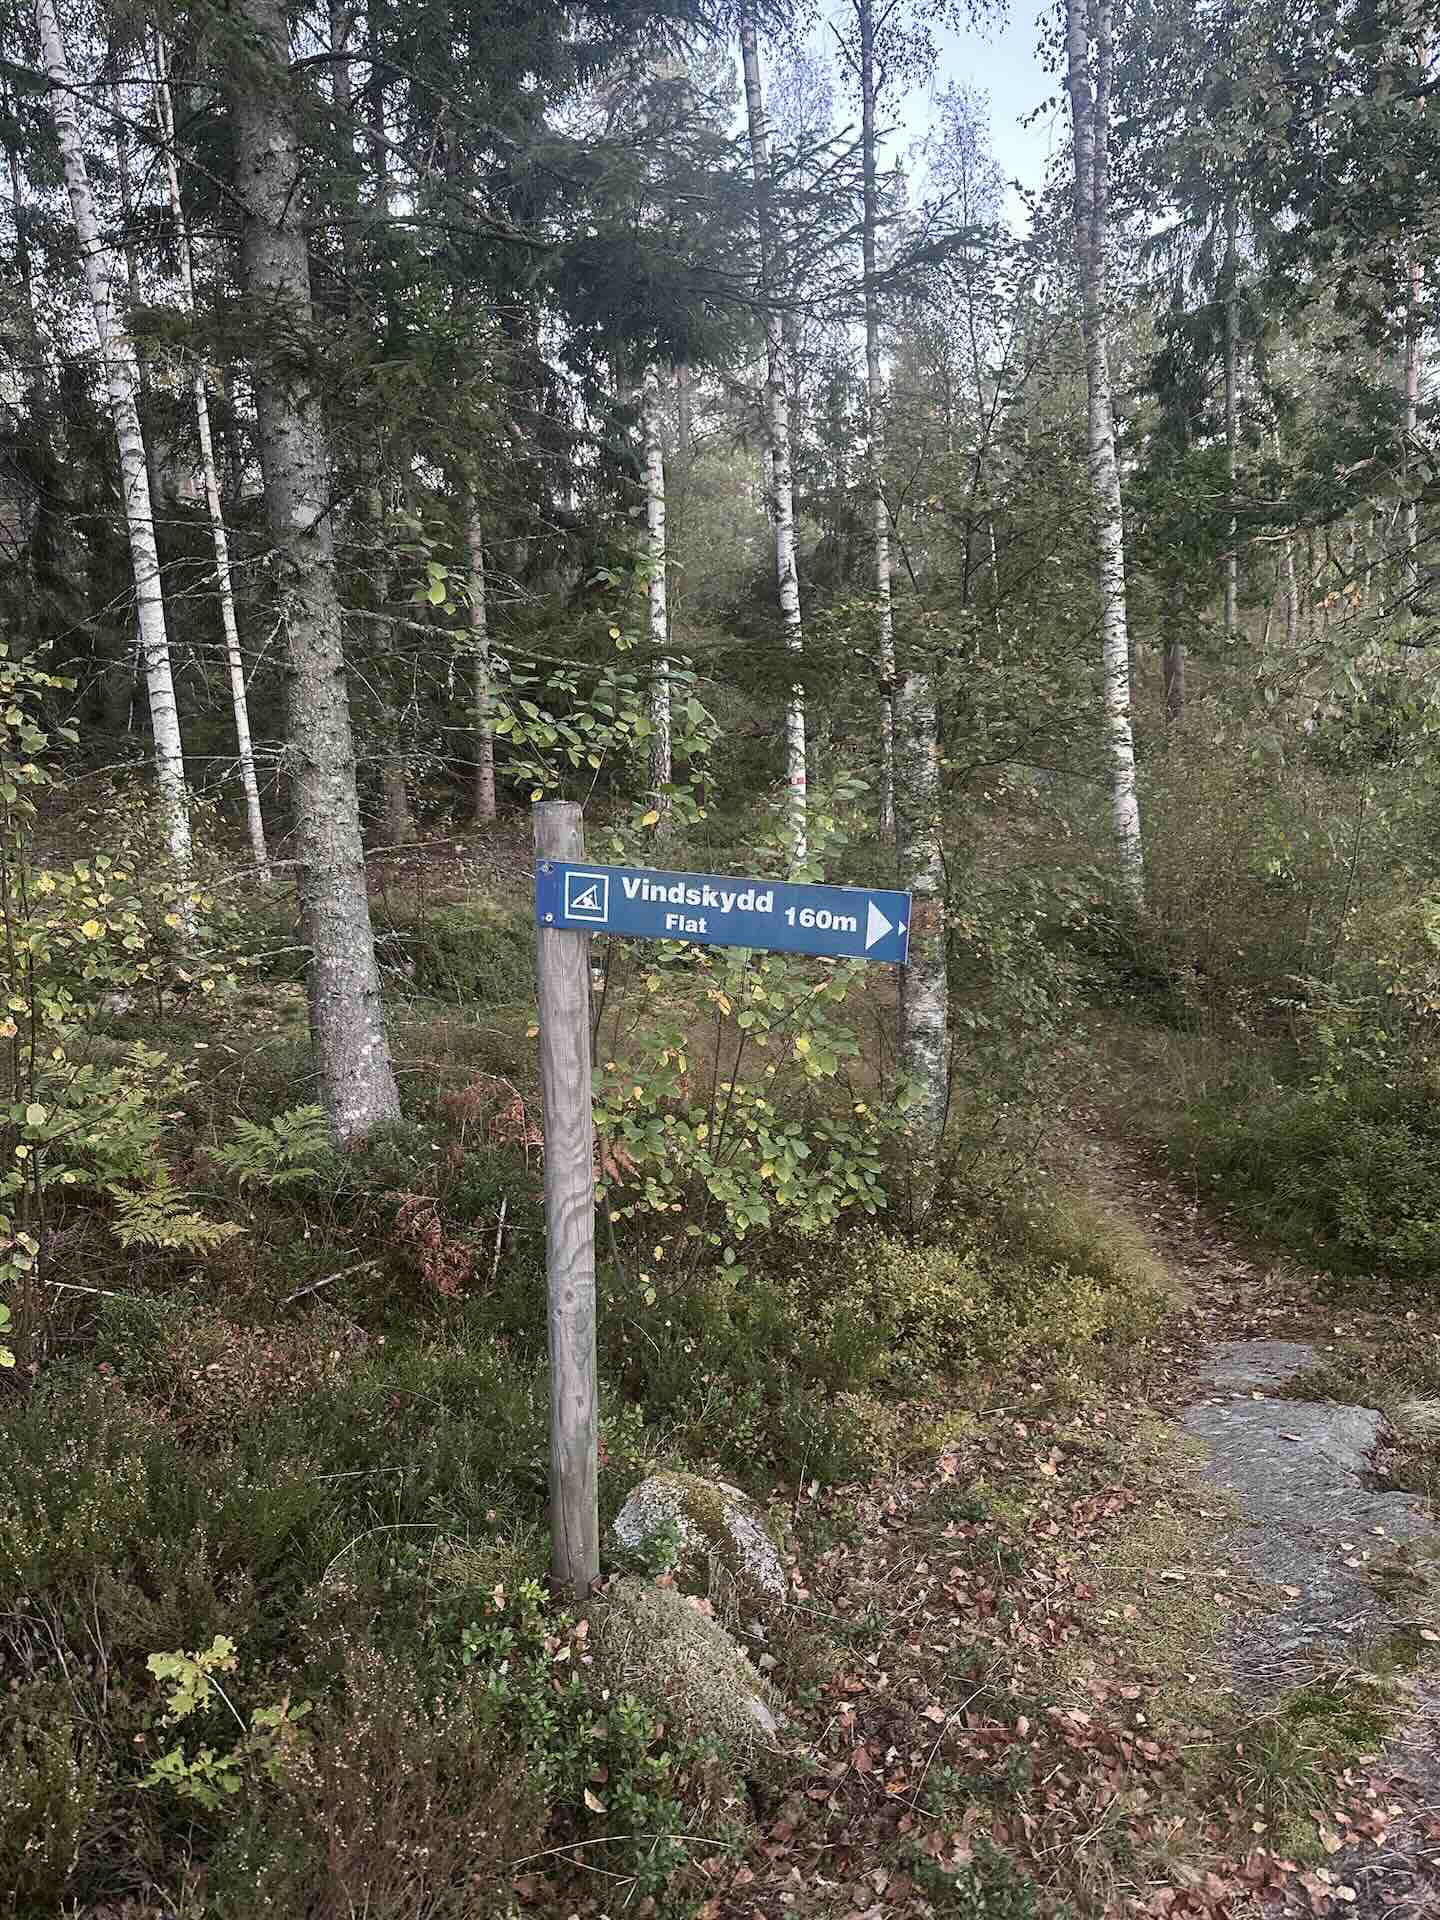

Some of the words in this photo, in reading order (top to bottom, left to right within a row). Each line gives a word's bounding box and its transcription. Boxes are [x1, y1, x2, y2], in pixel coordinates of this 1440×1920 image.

[621, 876, 774, 913] Vindskydd
[665, 912, 707, 934] Flat
[784, 906, 857, 932] 160m
